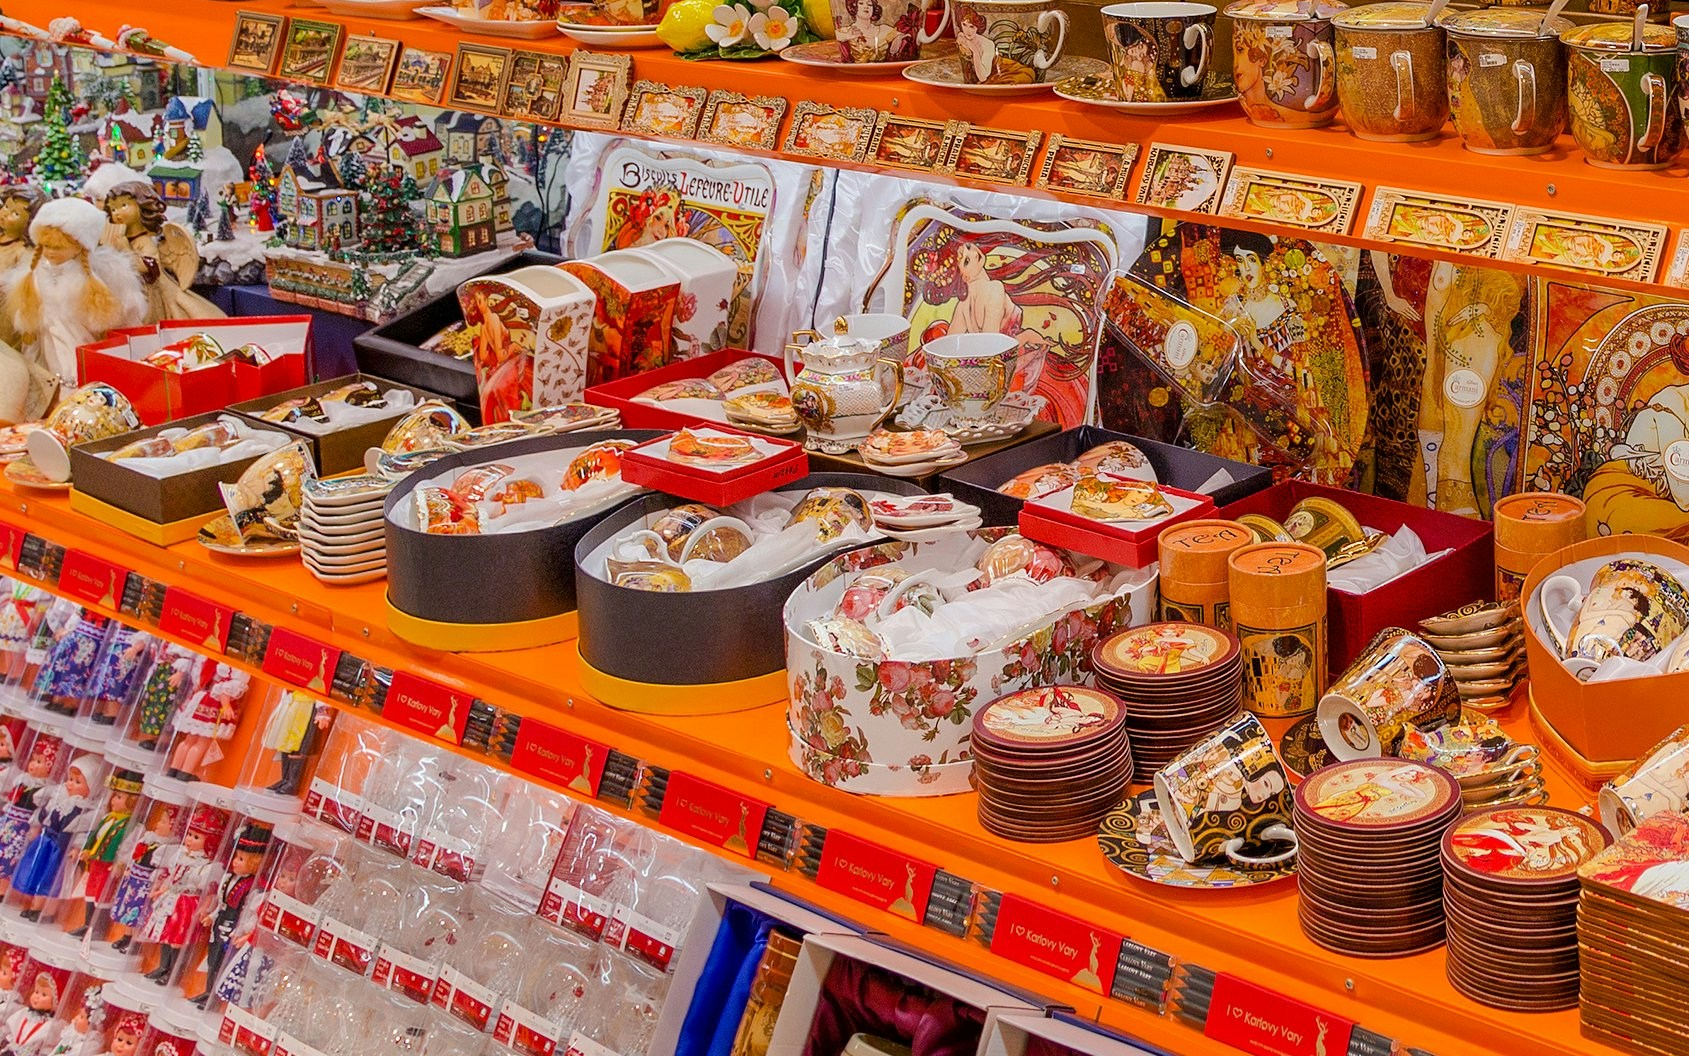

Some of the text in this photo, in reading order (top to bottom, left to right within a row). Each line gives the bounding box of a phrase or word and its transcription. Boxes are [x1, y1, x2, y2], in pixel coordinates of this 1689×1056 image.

[869, 127, 883, 153] PRAHA
[949, 138, 963, 165] PRAHA
[1041, 151, 1055, 178] PRAHA
[407, 698, 428, 714] Karlovy
[428, 705, 442, 719] Vary
[536, 746, 560, 763] Karlovy
[560, 755, 576, 769] Vary
[848, 862, 877, 884] Karlovy
[877, 872, 896, 890] Vary
[1026, 929, 1057, 952] Karlovy
[1058, 940, 1079, 960] Vary
[1244, 1010, 1279, 1037] Karlovy
[1281, 1025, 1303, 1047] Vary
